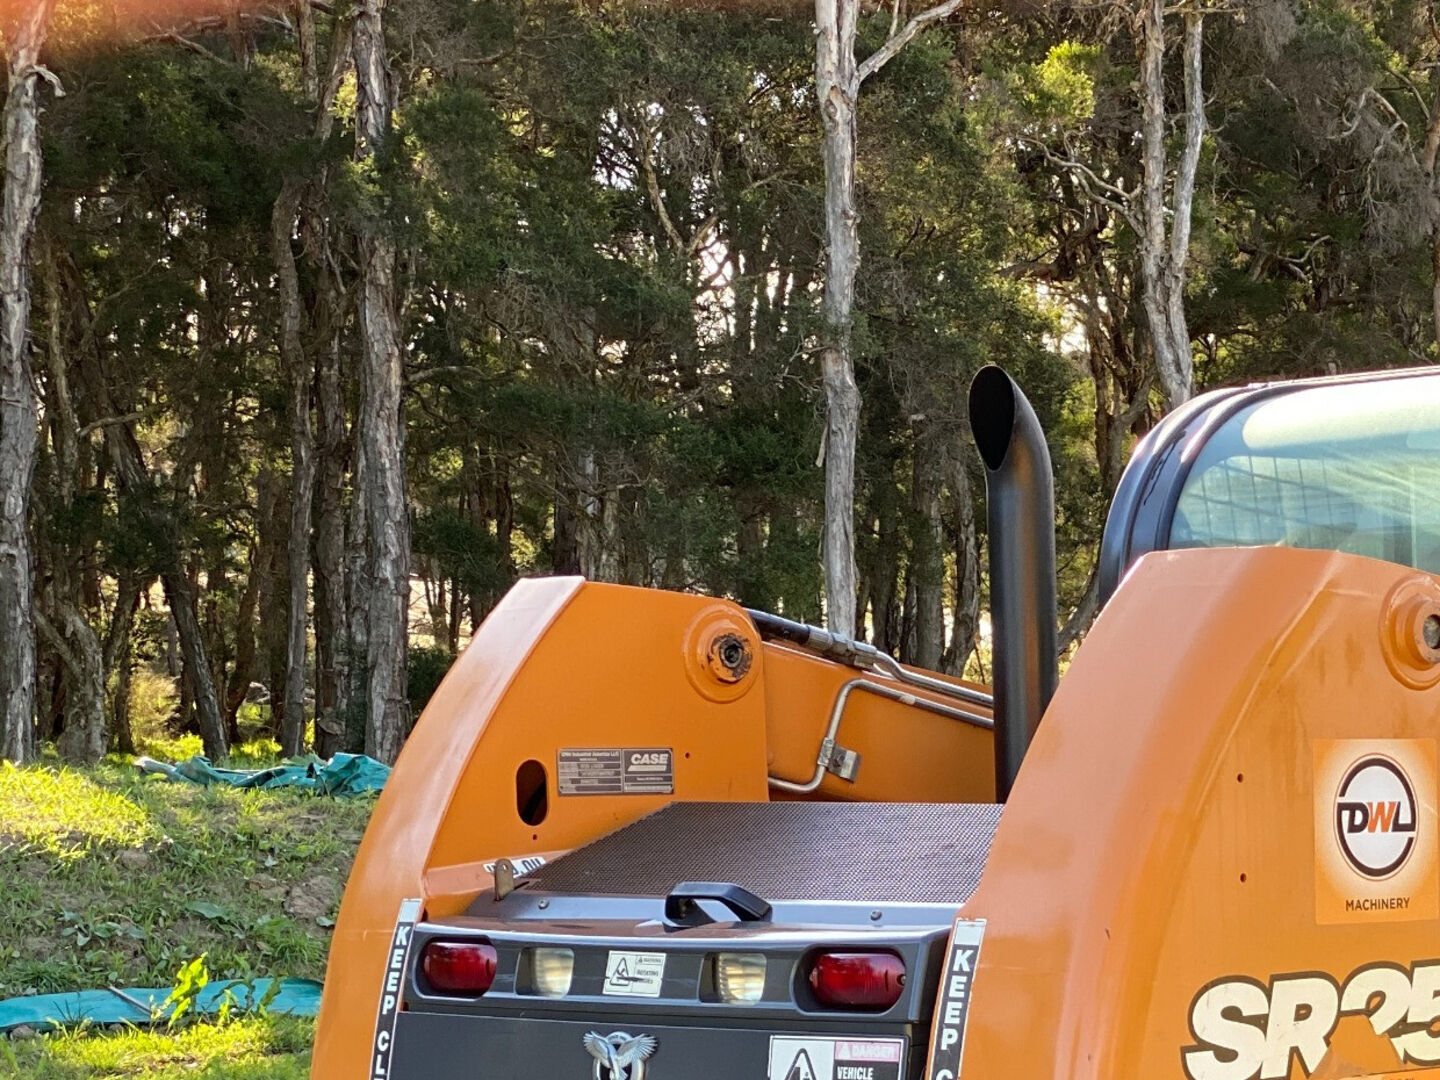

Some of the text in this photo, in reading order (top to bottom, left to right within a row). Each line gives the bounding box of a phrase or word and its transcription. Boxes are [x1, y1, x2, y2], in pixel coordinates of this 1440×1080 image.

[630, 753, 669, 765] CASE
[1337, 801, 1416, 833] DWL
[1345, 897, 1410, 912] MACHINERY
[382, 926, 410, 1016] KEEP
[940, 949, 974, 1051] KEEP
[852, 1043, 895, 1058] DANGER
[836, 1066, 874, 1080] VEHICLE
